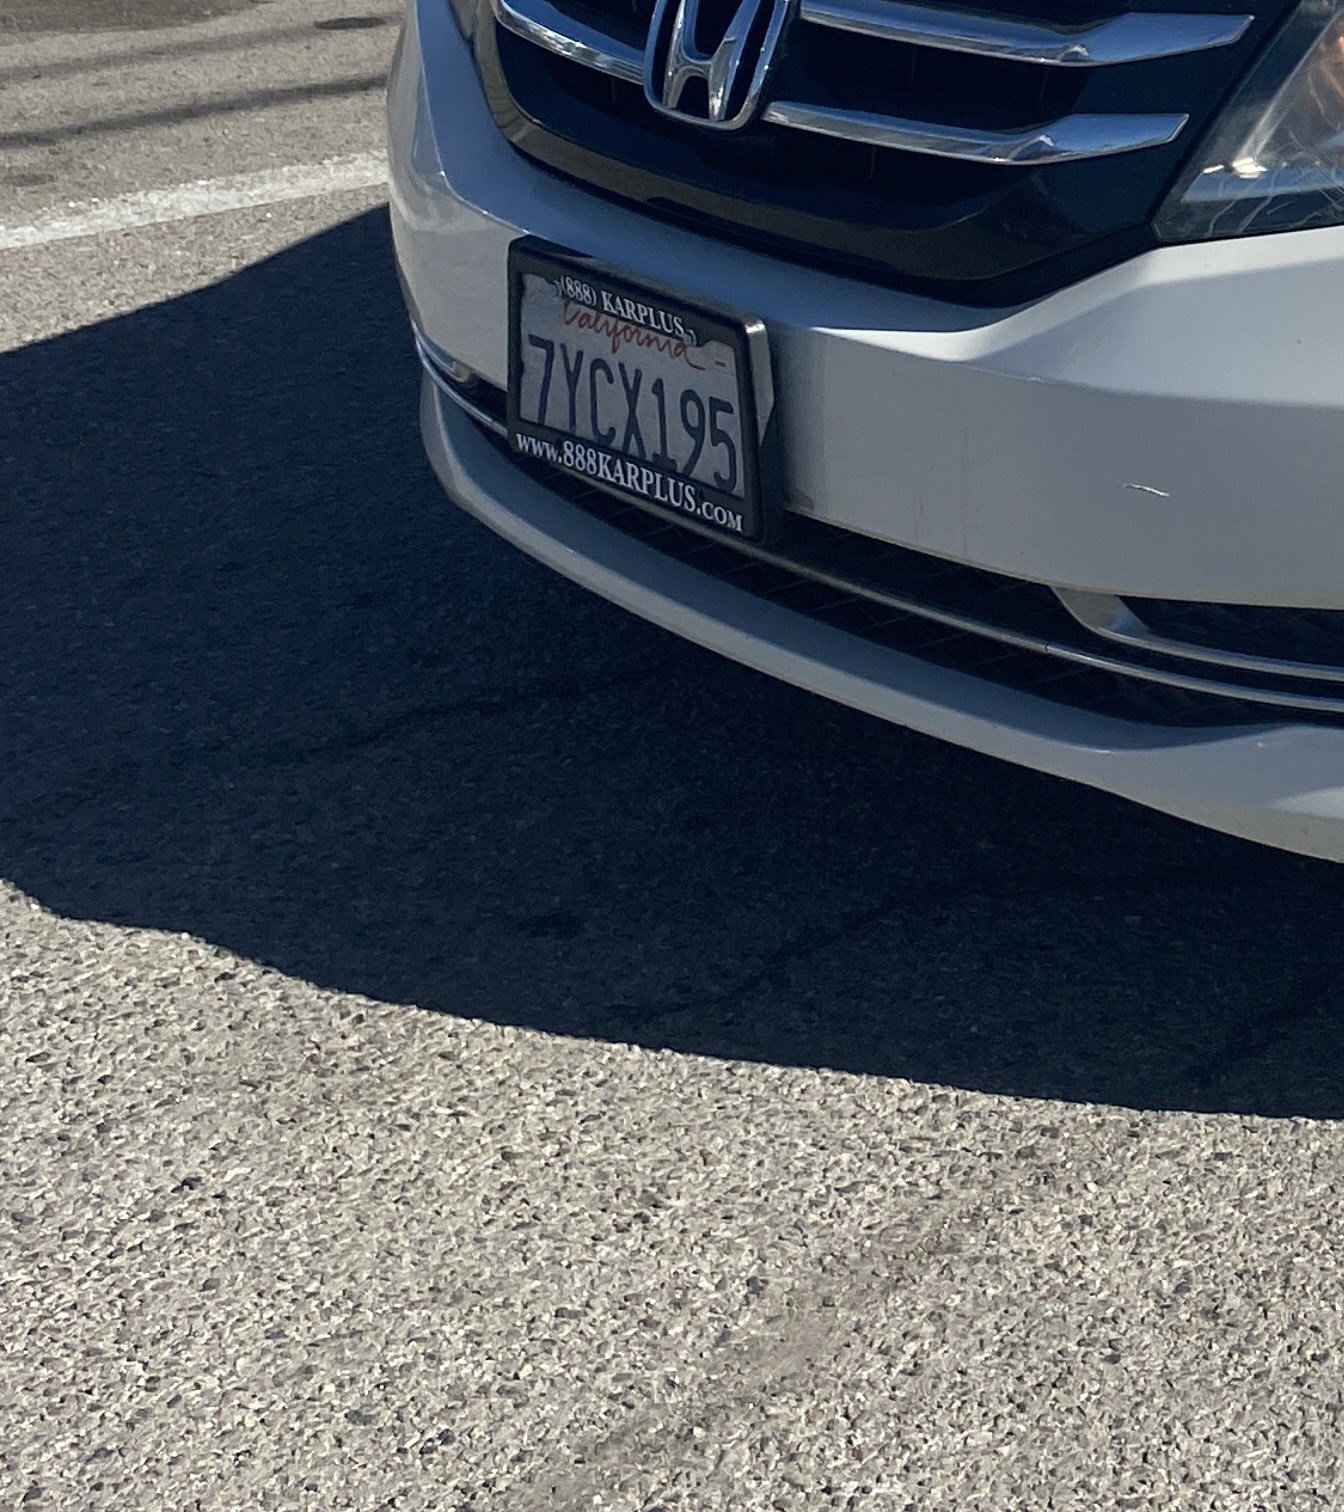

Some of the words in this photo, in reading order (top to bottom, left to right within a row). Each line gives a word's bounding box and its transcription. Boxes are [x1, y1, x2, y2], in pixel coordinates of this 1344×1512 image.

[563, 296, 706, 372] California
[600, 289, 685, 337] KARPLUS
[527, 334, 737, 492] 7YCX195
